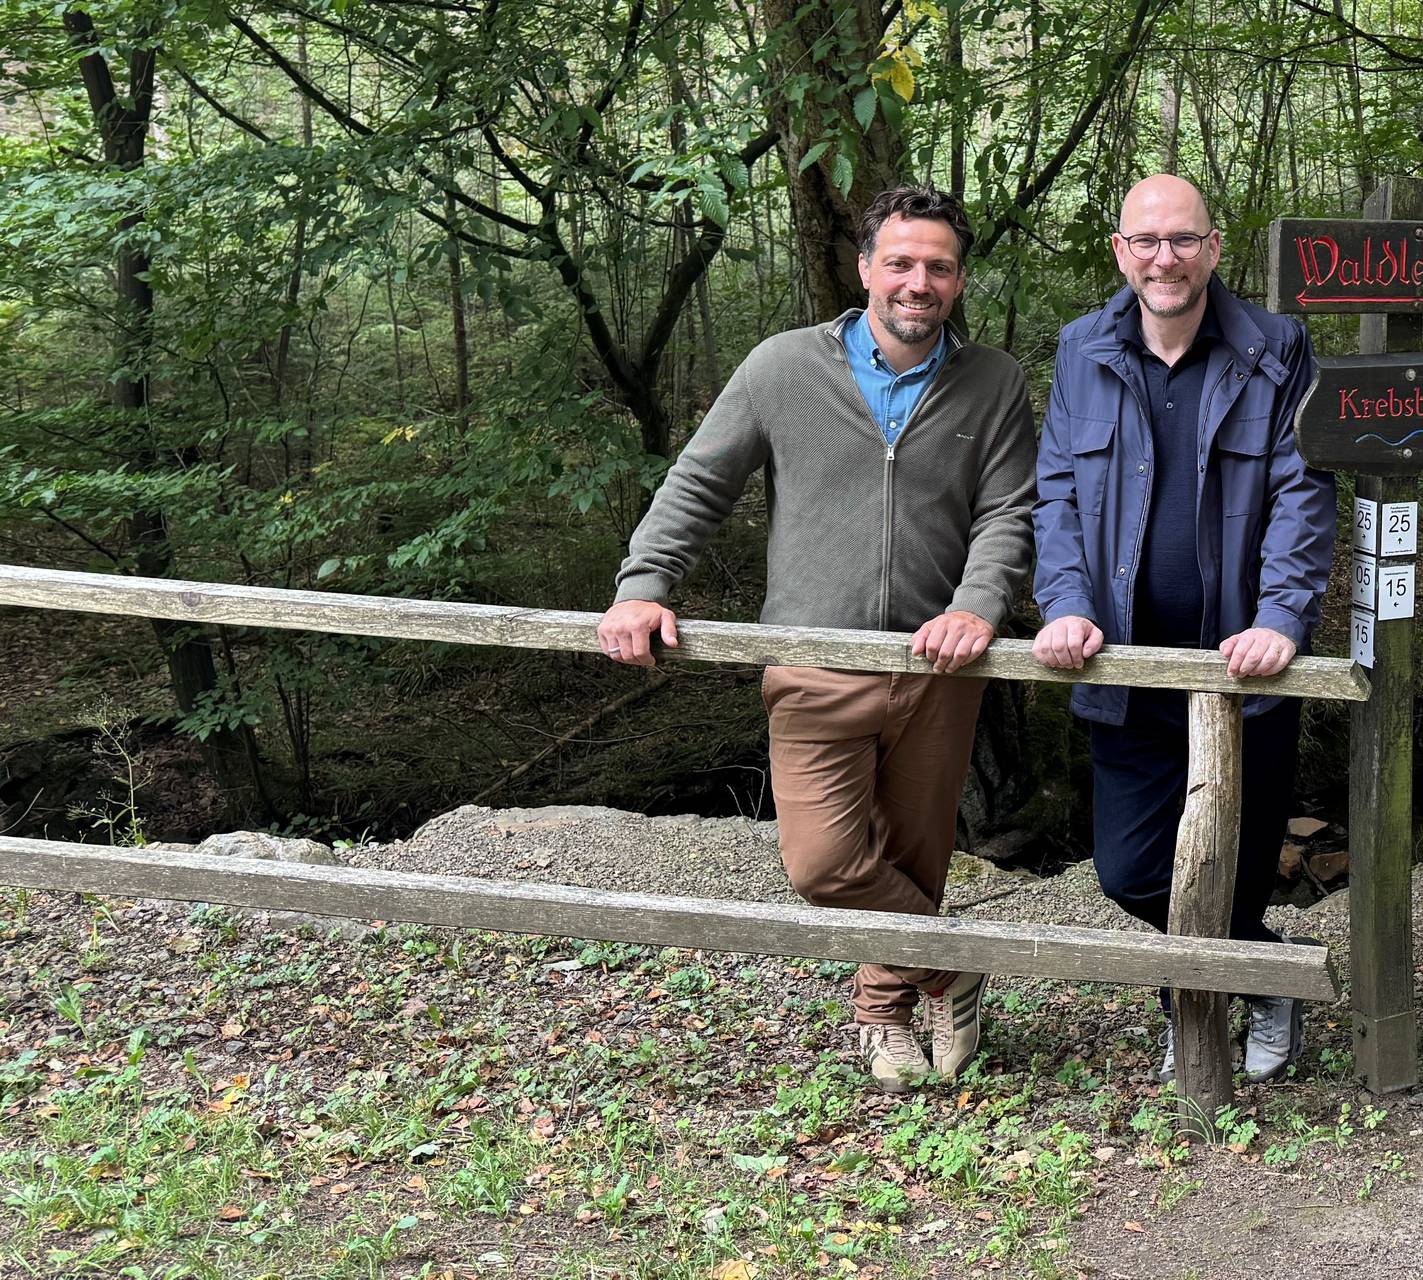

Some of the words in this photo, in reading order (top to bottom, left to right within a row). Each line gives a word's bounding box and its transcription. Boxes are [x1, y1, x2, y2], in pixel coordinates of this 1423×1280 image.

[1357, 510, 1371, 530] 25
[1389, 514, 1410, 533] 25
[1356, 565, 1370, 586] 05
[1386, 578, 1406, 597] 15
[1355, 623, 1368, 644] 15
